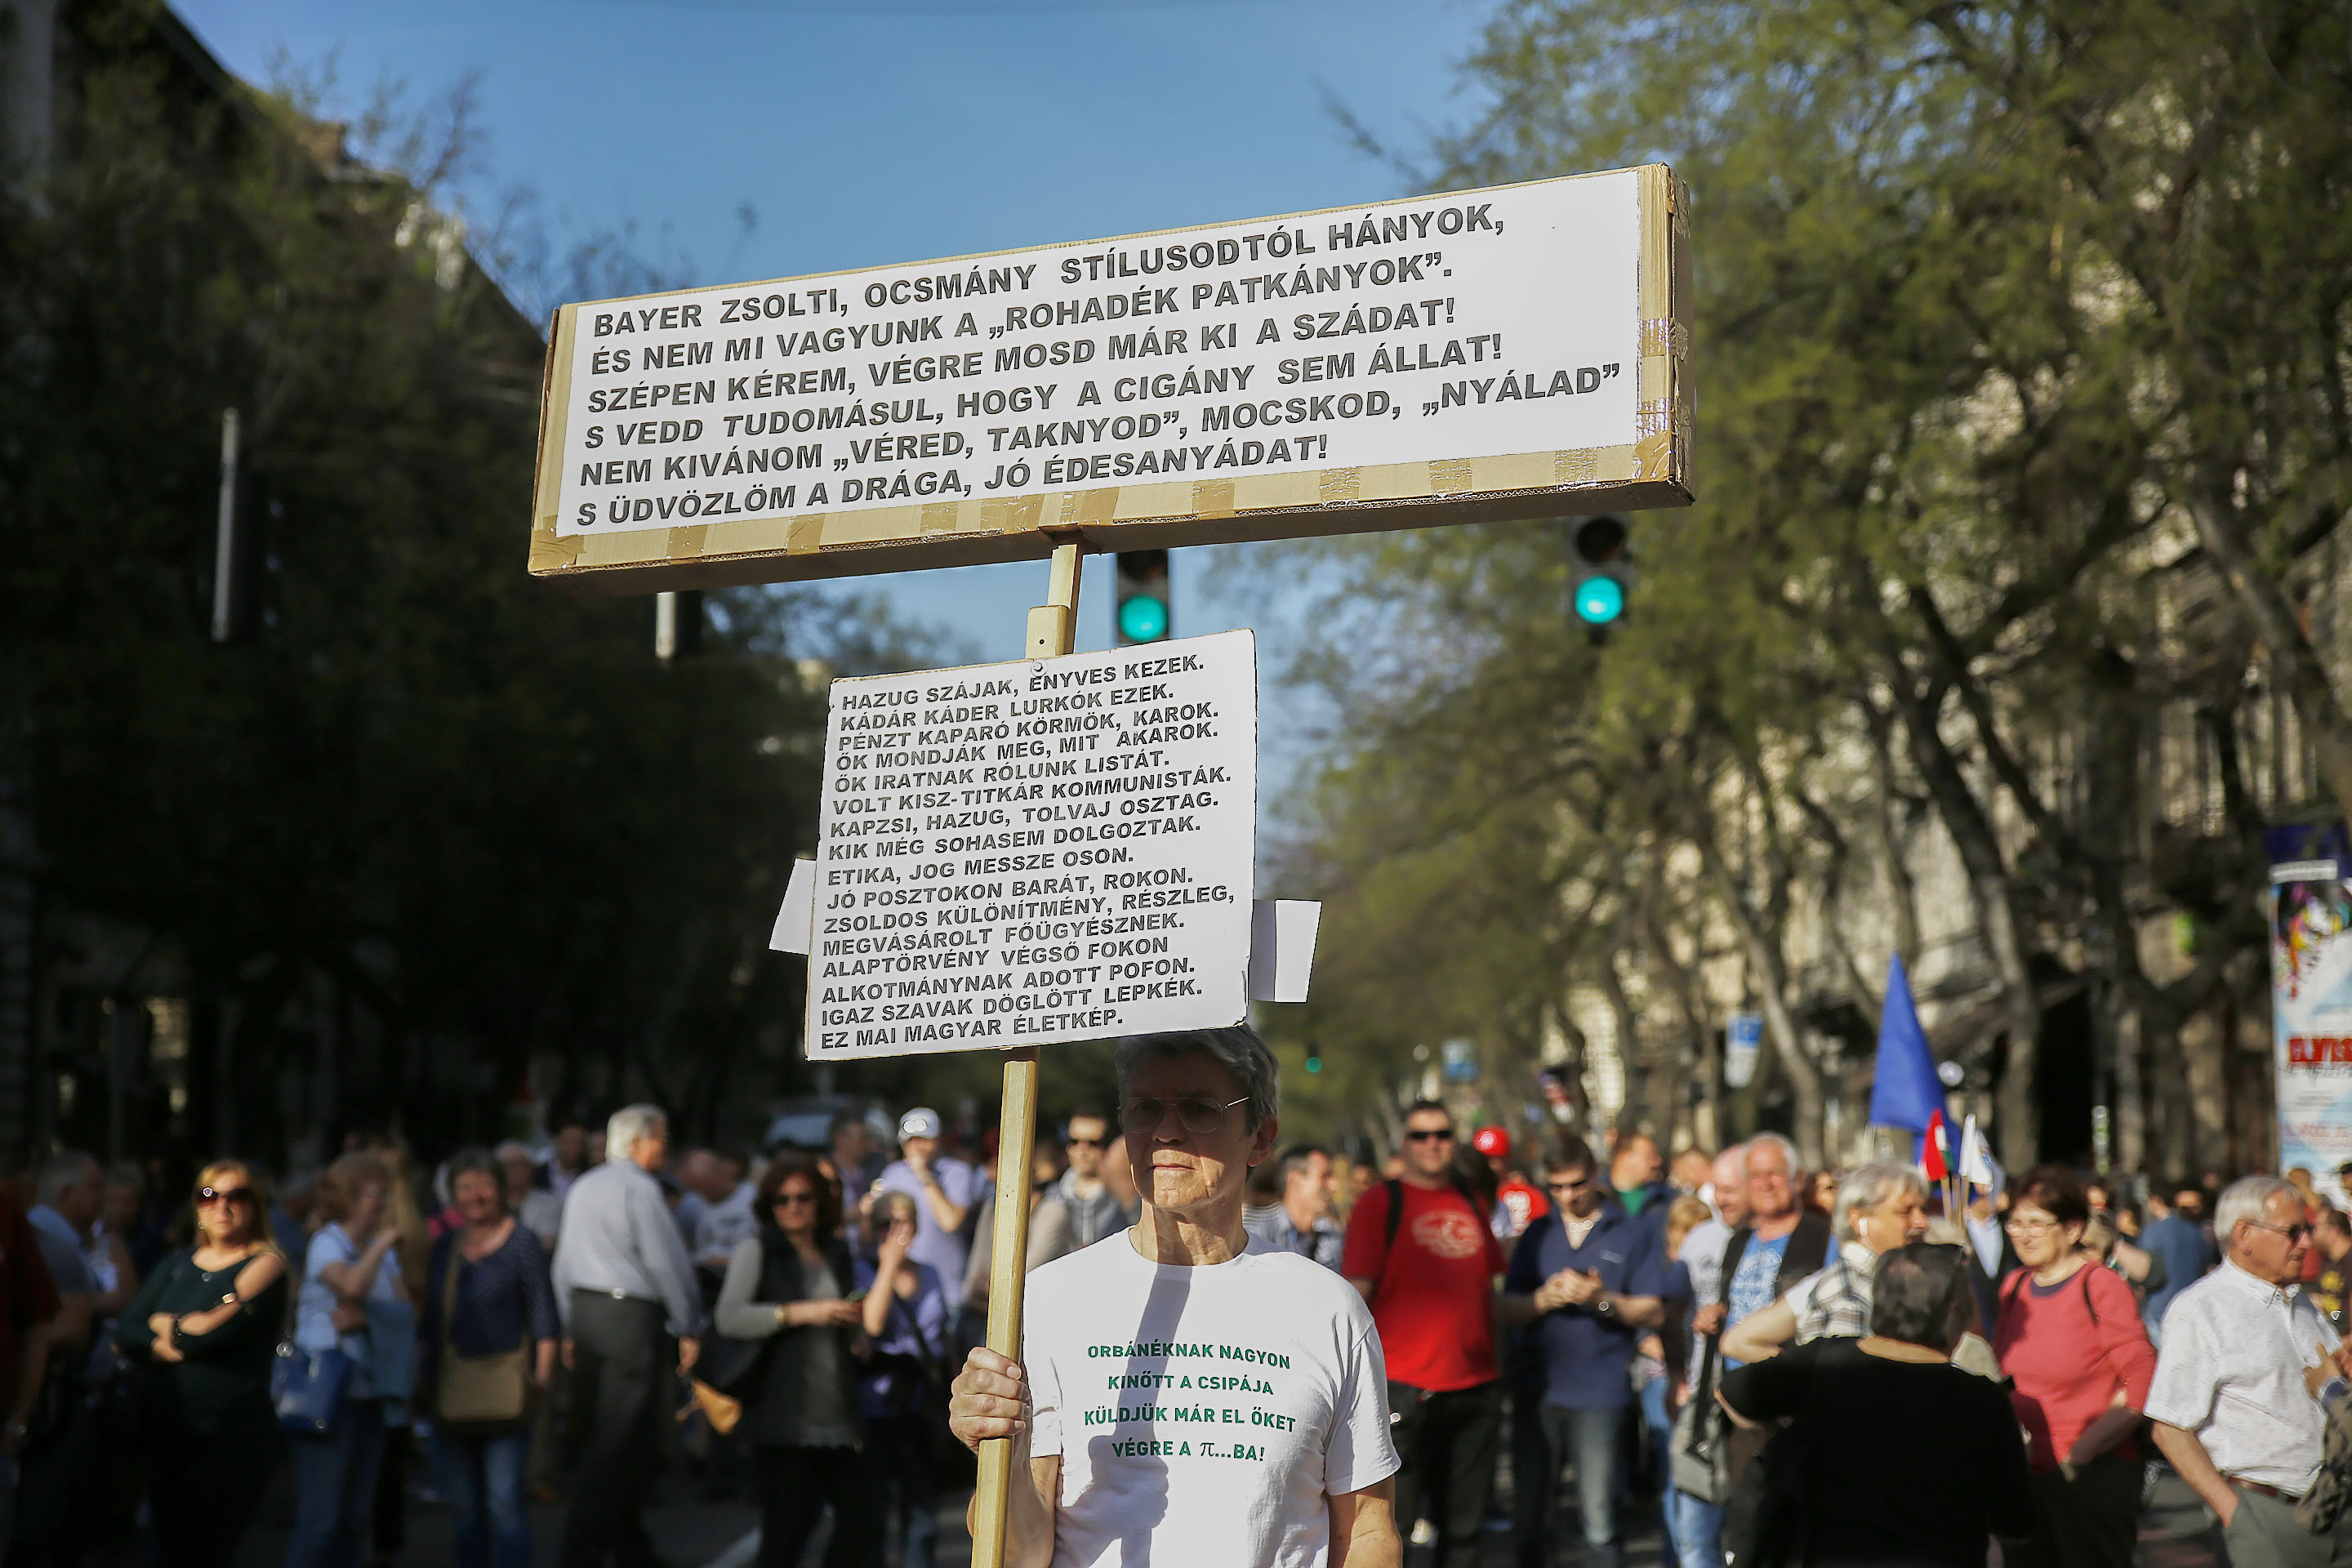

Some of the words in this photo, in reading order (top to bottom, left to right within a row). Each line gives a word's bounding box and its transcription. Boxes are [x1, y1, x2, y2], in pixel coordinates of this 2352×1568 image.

[595, 305, 702, 337] BAYER
[720, 288, 848, 323] ZSOLTI,
[865, 264, 1037, 308] OCSMÁNY
[1061, 226, 1316, 283] STÍLUSODTÓL
[1329, 203, 1503, 251] HÁNYOK,
[592, 345, 630, 375] ÉS
[644, 341, 713, 371] NEM
[724, 336, 763, 362] MI
[776, 315, 943, 357] VAGYUNK
[954, 312, 978, 337] A
[989, 284, 1179, 340] „ROHADÉK
[1192, 252, 1451, 310] PATKÁNYOK”.
[588, 380, 715, 412] SZÉPEN
[728, 367, 855, 401] KÉREM,
[868, 352, 983, 386] VÉGRE
[995, 340, 1095, 372] MOSD
[1108, 325, 1187, 360] MÁR
[1201, 323, 1236, 351] KI
[1255, 318, 1281, 345] A
[1293, 297, 1454, 341] SZÁDAT!
[585, 425, 604, 449] S
[617, 420, 703, 445] VEDD
[723, 399, 943, 437] TUDOMÁSUL,
[957, 384, 1058, 418] HOGY
[1076, 381, 1101, 407] A
[1114, 364, 1255, 402] CIGÁNY
[1277, 352, 1355, 384] SEM
[1367, 333, 1501, 376] ÁLLAT!
[581, 459, 652, 486] NEM
[664, 443, 822, 480] KIVÁNOM
[834, 432, 973, 472] „VÉRED,
[987, 410, 1187, 452] TAKNYOD”,
[1201, 390, 1401, 432] MOCSKOD,
[1423, 363, 1619, 416] „NYÁLAD”
[577, 503, 596, 526] S
[609, 483, 796, 523] ÜDVÖZLÖM
[806, 482, 829, 506] A
[841, 469, 971, 502] DRÁGA,
[984, 457, 1031, 490] JÓ
[1044, 434, 1327, 485] ÉDESANYÁDAT!
[843, 690, 918, 710] HAZUG
[926, 679, 1018, 702] SZÁJAK,
[1029, 666, 1116, 692] ENYVES
[1125, 654, 1204, 679] KEZEK.
[839, 732, 911, 751] PÉNZT
[918, 720, 1009, 745] KAPARÓ
[1017, 711, 1120, 737] KÖRMÖK,
[1134, 702, 1218, 726] KAROK.
[840, 710, 916, 731] KÁDÁR
[924, 705, 999, 725] KÁDER
[1010, 690, 1102, 717] LURKÓK
[1111, 683, 1174, 706] EZEK.
[836, 752, 868, 770] ŐK
[875, 743, 986, 768] MONDJÁK
[997, 741, 1051, 760] MEG,
[1060, 734, 1099, 753] MIT
[1116, 721, 1218, 747] AKAROK.
[833, 797, 892, 815] VOLT
[899, 782, 1044, 810] KISZ-TITKÁR
[1052, 764, 1231, 799] KOMMUNISTÁK.
[835, 774, 866, 792] ŐK
[875, 768, 974, 790] IRATNAK
[983, 760, 1077, 782] RÓLUNK
[1085, 748, 1169, 773] LISTÁT.
[829, 843, 868, 860] KIK
[876, 834, 924, 857] MÉG
[934, 830, 1045, 853] SOHASEM
[1054, 815, 1200, 844] DOLGOZTAK.
[831, 817, 918, 838] KAPZSI,
[926, 809, 1010, 831] HAZUG,
[1022, 800, 1110, 823] TOLVAJ
[1120, 791, 1218, 816] OSZTAG.
[826, 889, 856, 909] JÓ
[863, 883, 1002, 907] POSZTOKON
[1012, 873, 1094, 897] BARÁT,
[1103, 867, 1192, 890] ROKON.
[828, 866, 901, 886] ETIKA,
[909, 862, 955, 880] JOG
[964, 853, 1054, 875] MESSZE
[1062, 847, 1134, 866] OSON.
[823, 911, 928, 933] ZSOLDOS
[938, 896, 1112, 926] KÜLÖNÍTMÉNY,
[1122, 885, 1234, 911] RÉSZLEG,
[822, 949, 990, 978] ALAPTÖRVÉNY
[1000, 941, 1080, 965] VÉGSŐ
[1088, 936, 1168, 960] FOKON
[823, 929, 992, 956] MEGVÁSÁROLT
[1005, 912, 1184, 943] FŐÜGYÉSZNEK.
[822, 973, 1013, 1004] ALKOTMÁNYNAK
[1022, 965, 1101, 988] ADOTT
[1109, 957, 1195, 981] POFON.
[822, 1006, 874, 1026] IGAZ
[882, 998, 973, 1021] SZAVAK
[983, 988, 1092, 1015] DÖGLÖTT
[1104, 977, 1202, 1004] LEPKÉK.
[822, 1031, 849, 1049] EZ
[856, 1027, 896, 1046] MAI
[905, 1019, 1001, 1042] MAGYAR
[1013, 1006, 1123, 1035] ÉLETKÉP.
[1088, 1339, 1214, 1358] ORBÁNÉKNAK
[1219, 1345, 1290, 1370] NAGYON
[1108, 1370, 1174, 1390] KINŐTT
[1180, 1375, 1192, 1389] A
[1198, 1374, 1274, 1395] CSIPÁJA
[1085, 1403, 1168, 1426] KÜLDJÜK
[1174, 1404, 1215, 1423] MÁR
[1223, 1409, 1245, 1423] EL
[1251, 1406, 1296, 1432] ŐKET
[1111, 1437, 1174, 1457] VÉGRE
[1178, 1441, 1191, 1456] A
